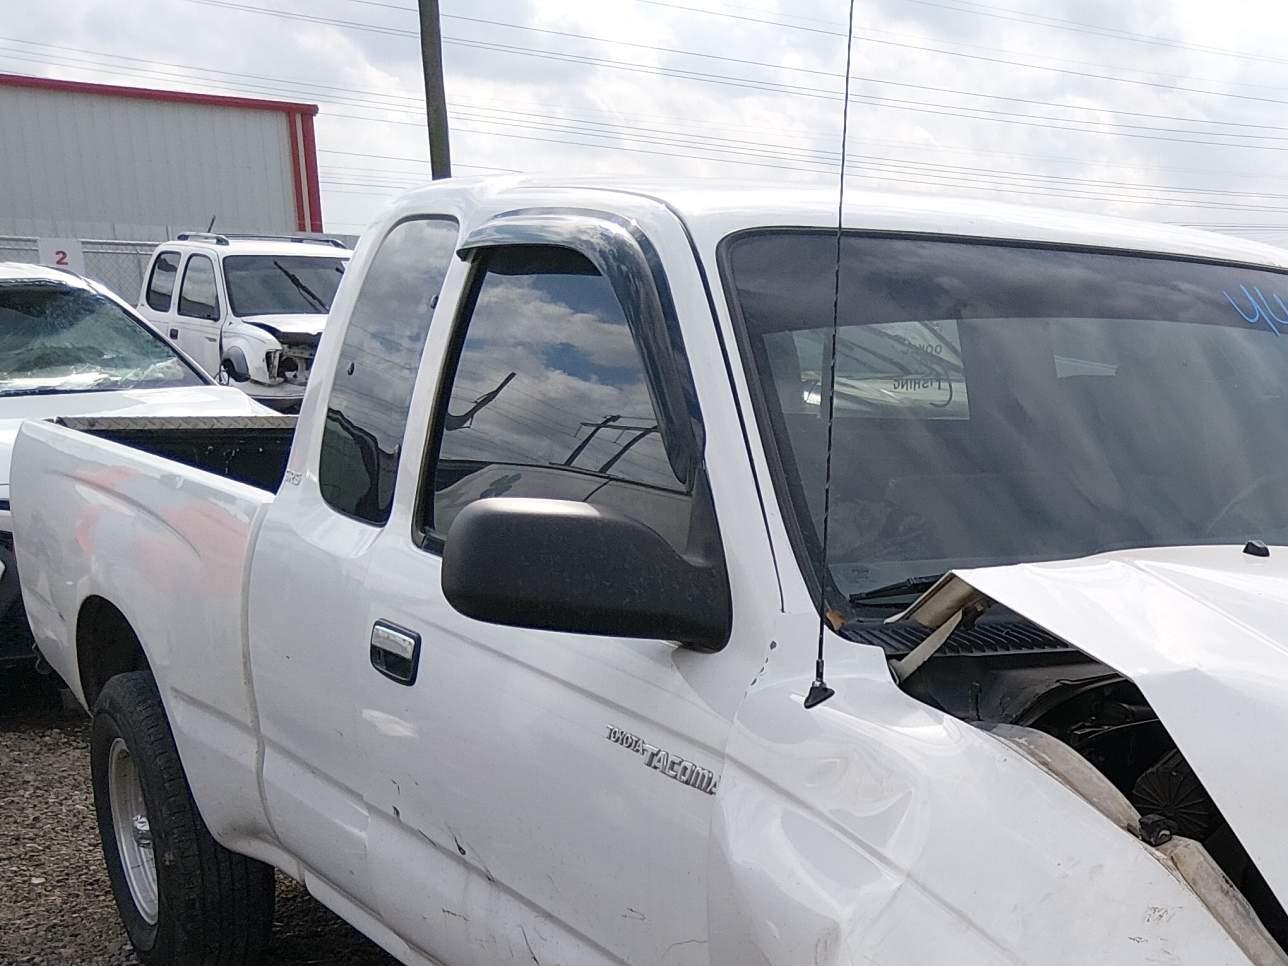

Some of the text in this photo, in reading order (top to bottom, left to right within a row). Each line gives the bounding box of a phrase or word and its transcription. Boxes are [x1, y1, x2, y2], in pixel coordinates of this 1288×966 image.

[55, 251, 69, 266] 2
[607, 725, 722, 796] TOYOTA TACOMA
